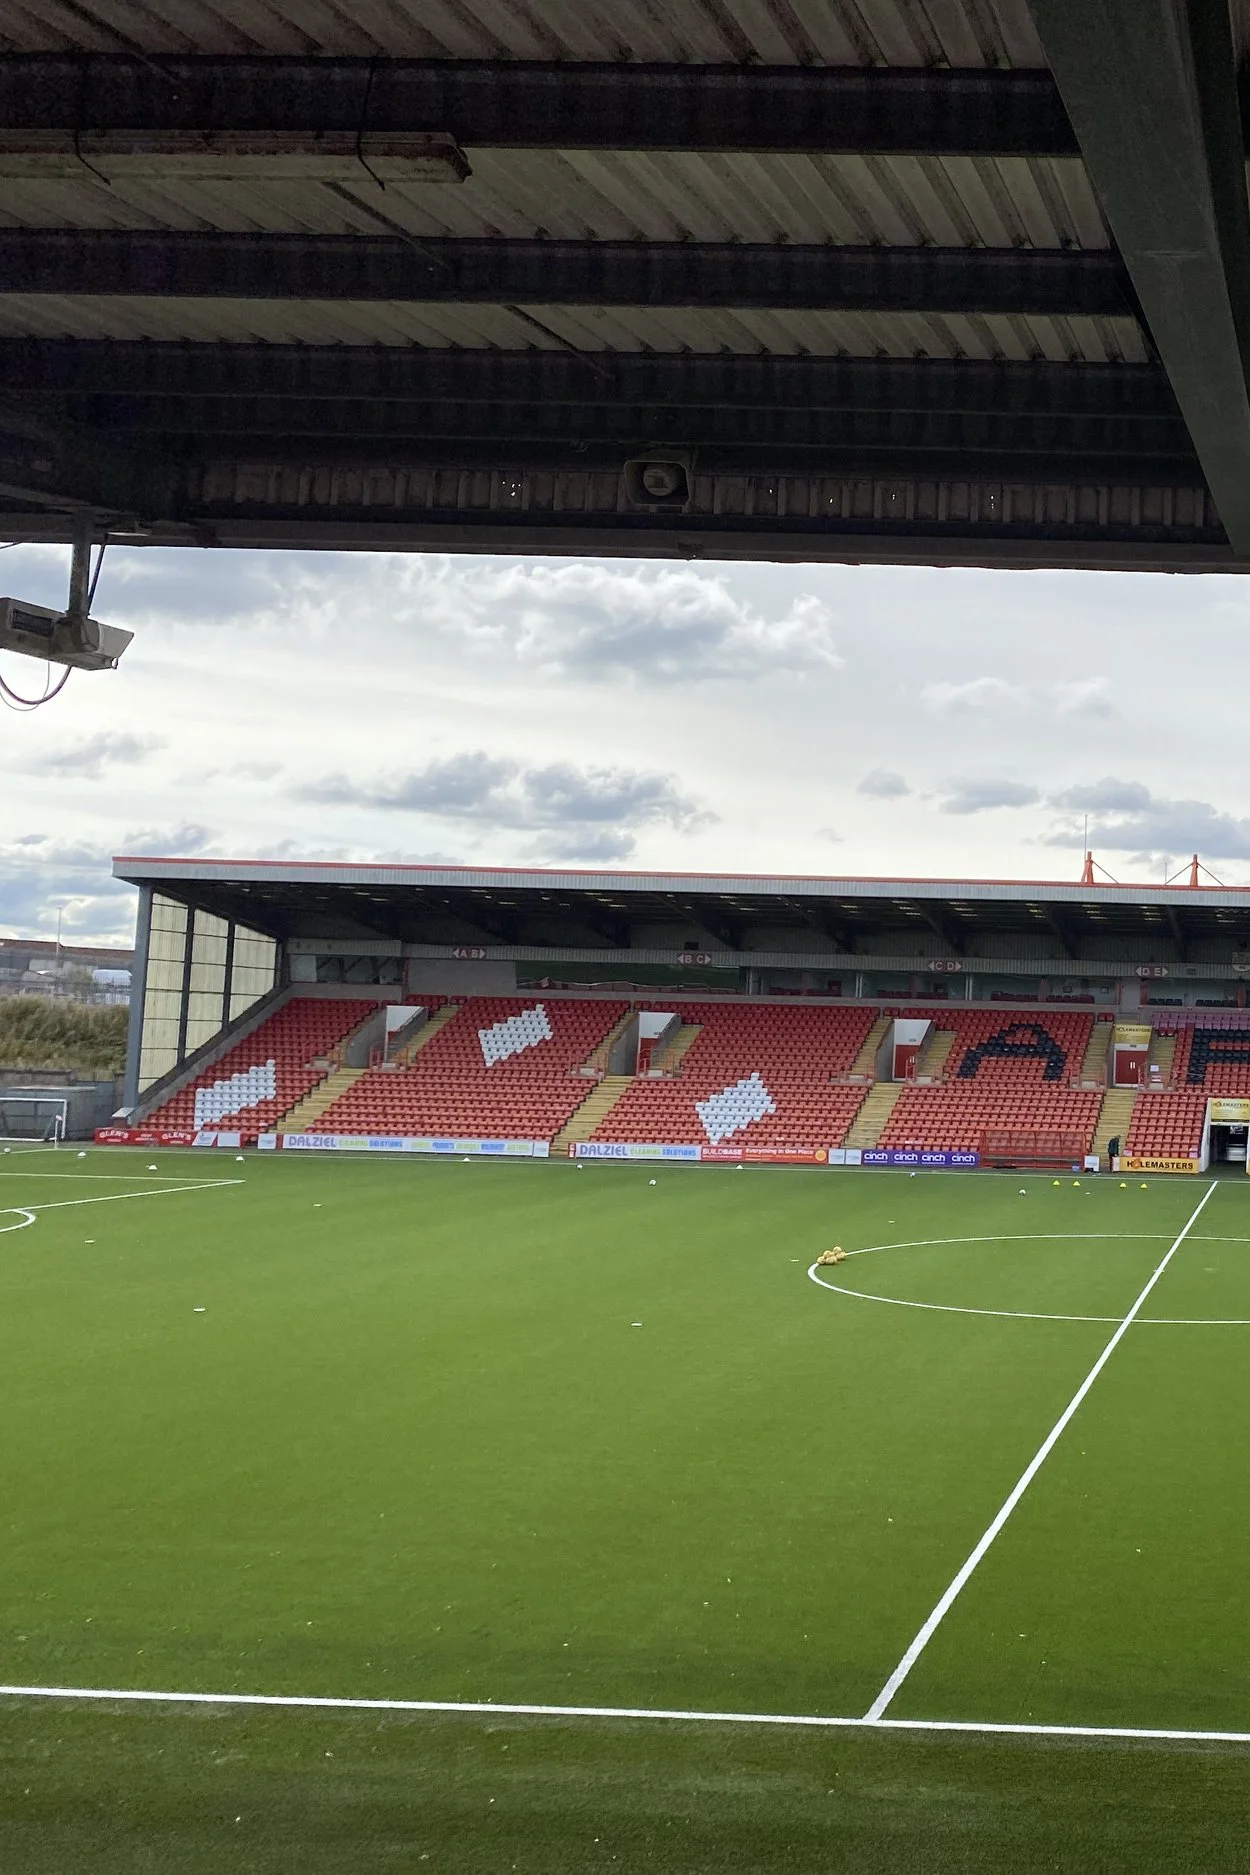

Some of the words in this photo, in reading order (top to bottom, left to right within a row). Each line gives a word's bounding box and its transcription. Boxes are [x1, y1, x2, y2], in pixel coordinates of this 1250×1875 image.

[956, 1022, 1067, 1082] A
[288, 1135, 337, 1148] DALZIEL
[580, 1144, 628, 1156] DALZIEL
[662, 1148, 697, 1157] SOLUTIONS
[702, 1148, 743, 1156] BUILDBASE
[745, 1148, 777, 1156] Everything
[864, 1150, 888, 1160] cinch
[894, 1151, 918, 1161] cinch
[922, 1152, 945, 1162] cinch
[951, 1153, 976, 1163] cinch
[1127, 1157, 1194, 1170] HOLEMASTERS
